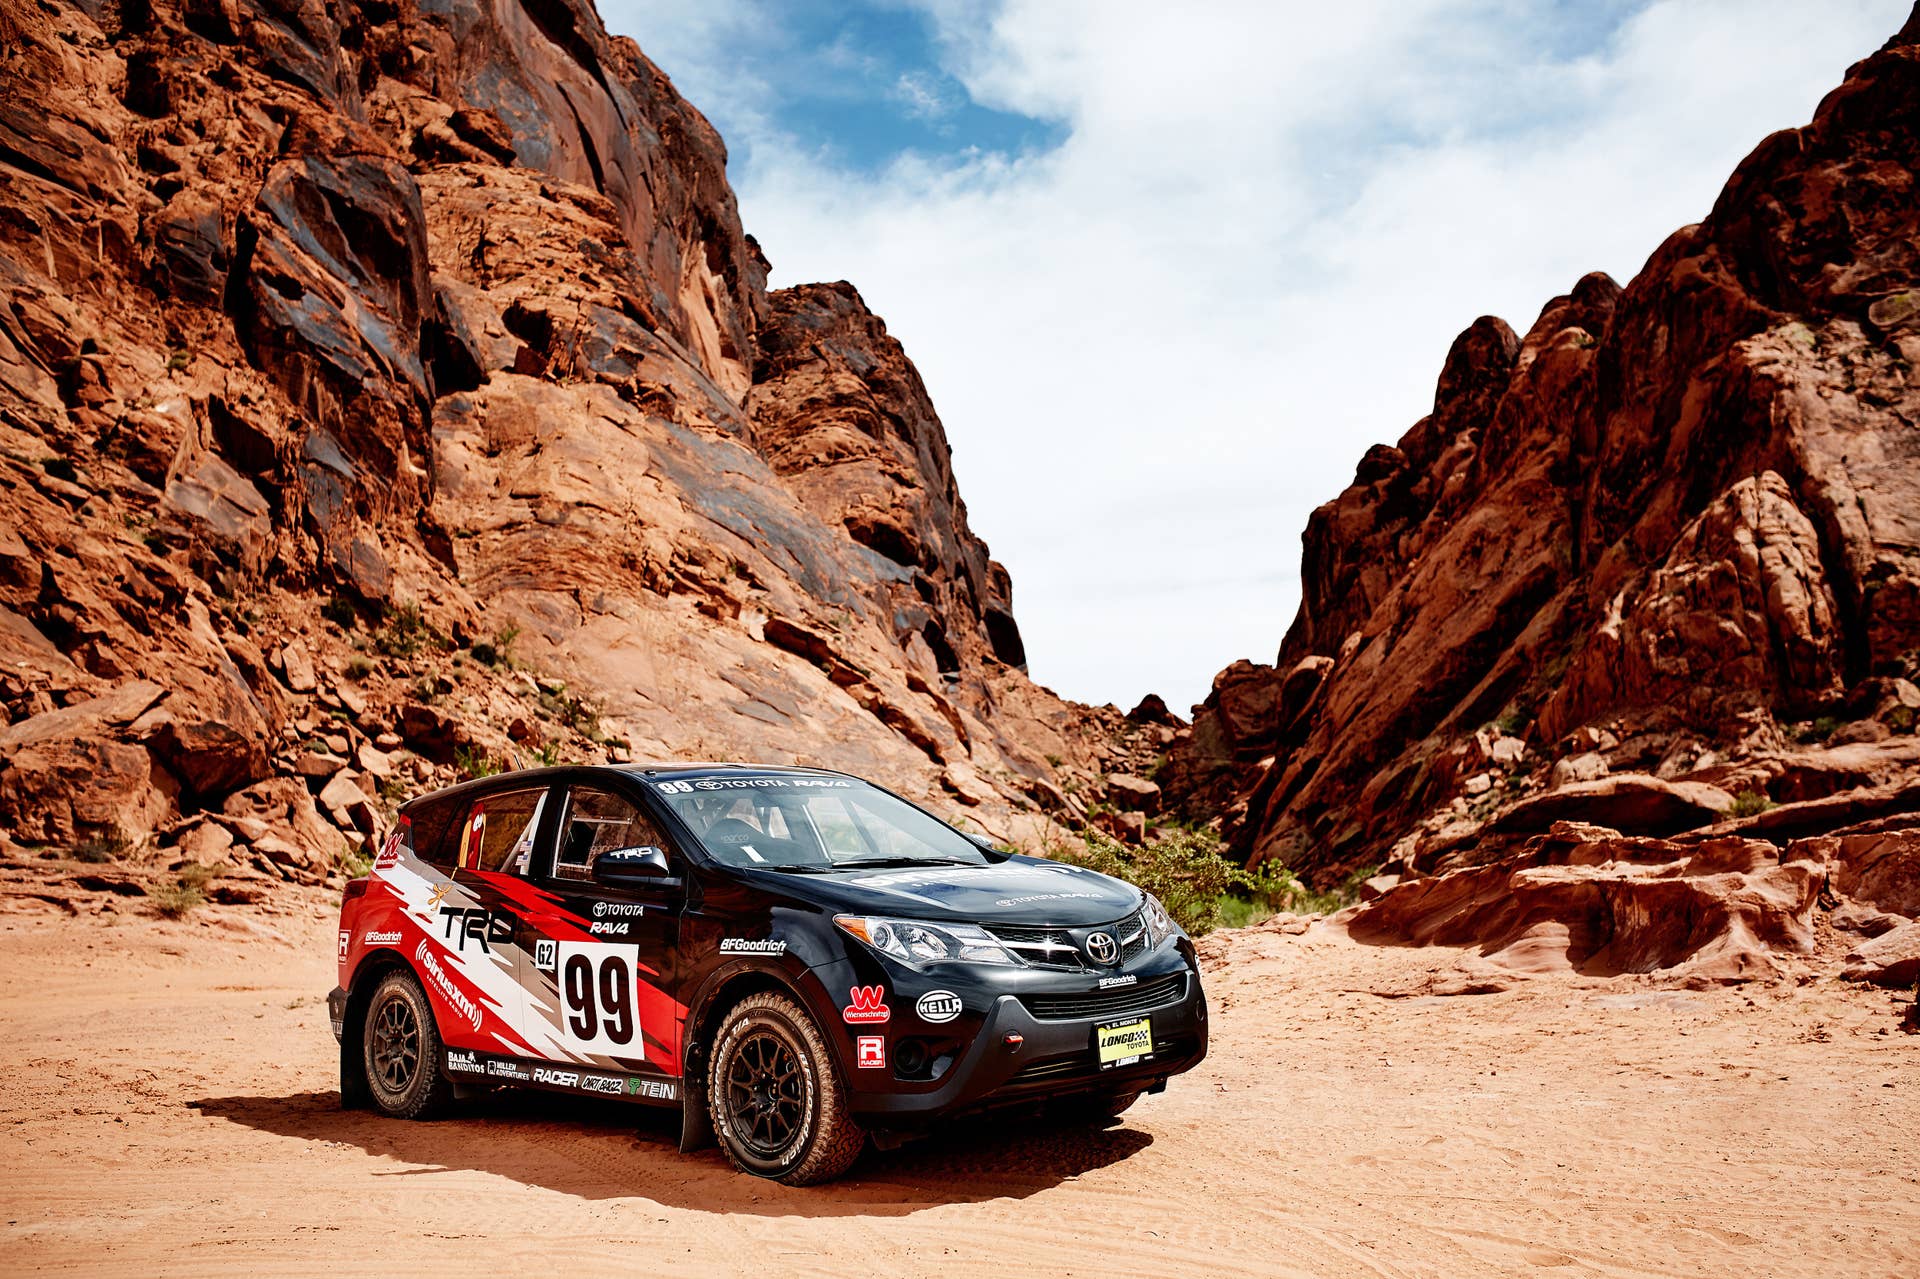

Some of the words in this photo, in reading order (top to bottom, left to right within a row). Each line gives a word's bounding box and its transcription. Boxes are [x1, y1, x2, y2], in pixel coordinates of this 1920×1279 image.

[657, 780, 694, 794] 99
[721, 780, 790, 788] TOYOTA
[792, 780, 850, 788] RAV4
[609, 847, 653, 859] TRD
[1014, 894, 1060, 904] TOYOTA
[607, 904, 644, 917] TOYOTA
[439, 906, 518, 954] TRD
[589, 921, 629, 935] RAV4
[365, 931, 402, 941] BFGoodrich
[720, 938, 787, 952] BFGoodrich
[537, 944, 553, 966] G2
[1098, 974, 1137, 986] BFGoodrich
[565, 954, 633, 1045] 99
[919, 997, 962, 1013] HELLA
[448, 1002, 462, 1018] RADIO
[1101, 1032, 1135, 1048] LONGO
[1126, 1040, 1150, 1050] TOYOTA
[447, 1051, 466, 1062] BAJA
[448, 1062, 485, 1074] BANDITOS
[495, 1070, 530, 1081] ADVENTURES
[533, 1068, 579, 1087] RACER
[641, 1080, 675, 1100] TEIN
[781, 1051, 814, 1166] BFGoodrich
